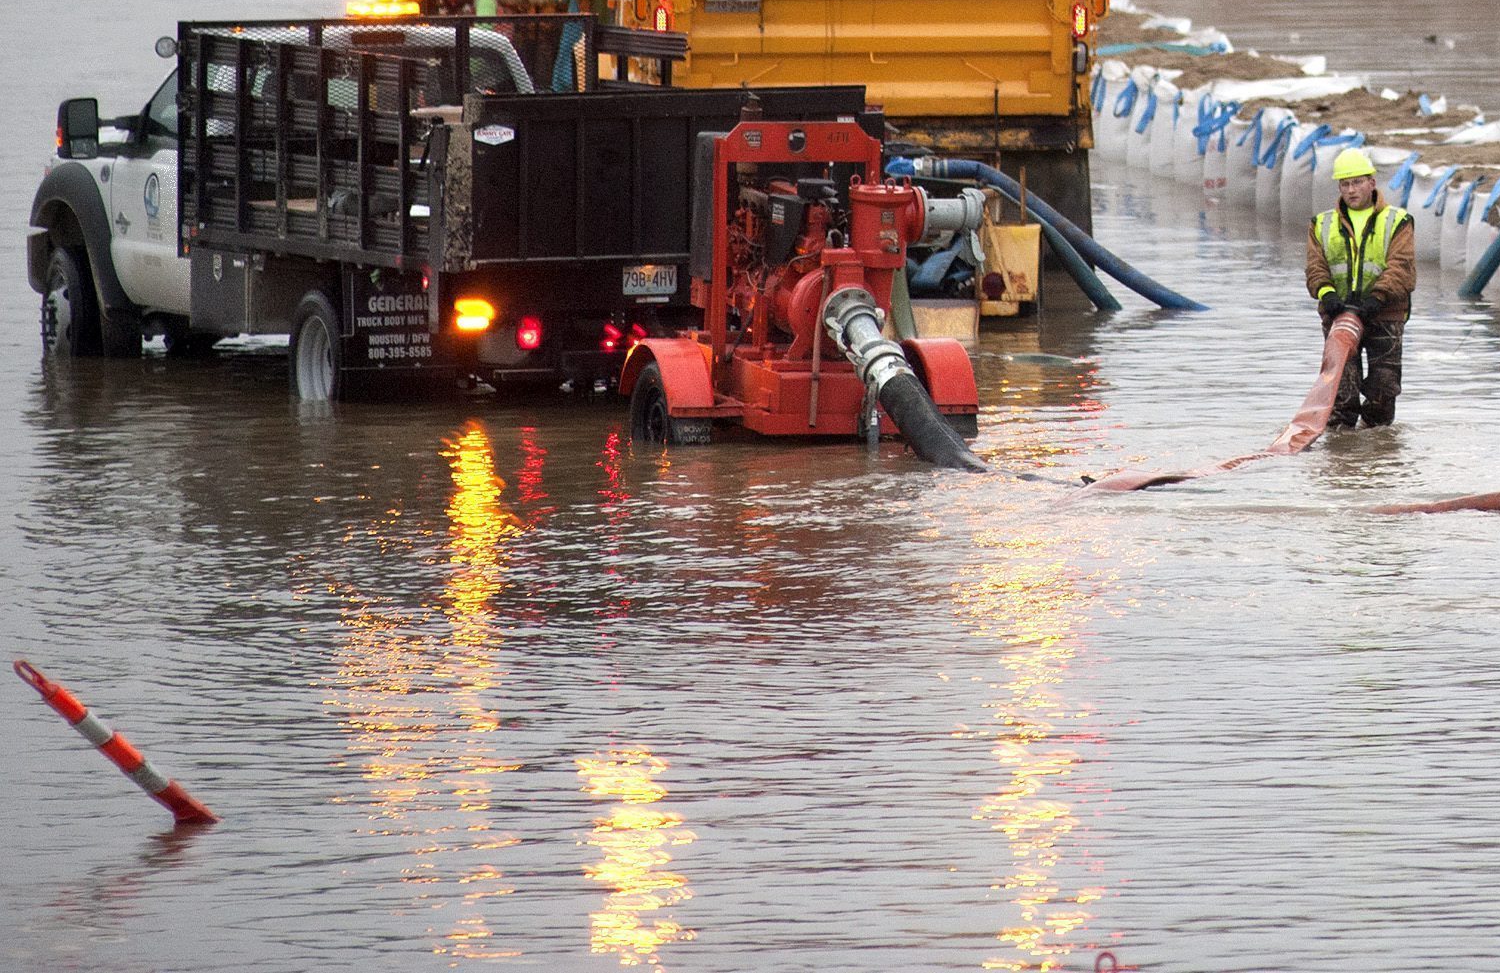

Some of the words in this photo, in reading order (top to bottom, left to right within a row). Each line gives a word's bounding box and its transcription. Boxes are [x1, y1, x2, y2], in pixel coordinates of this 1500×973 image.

[368, 294, 429, 314] GENERAL
[357, 316, 383, 328] TRUCK
[384, 315, 405, 327] BODY
[368, 334, 405, 346] HOUSTON
